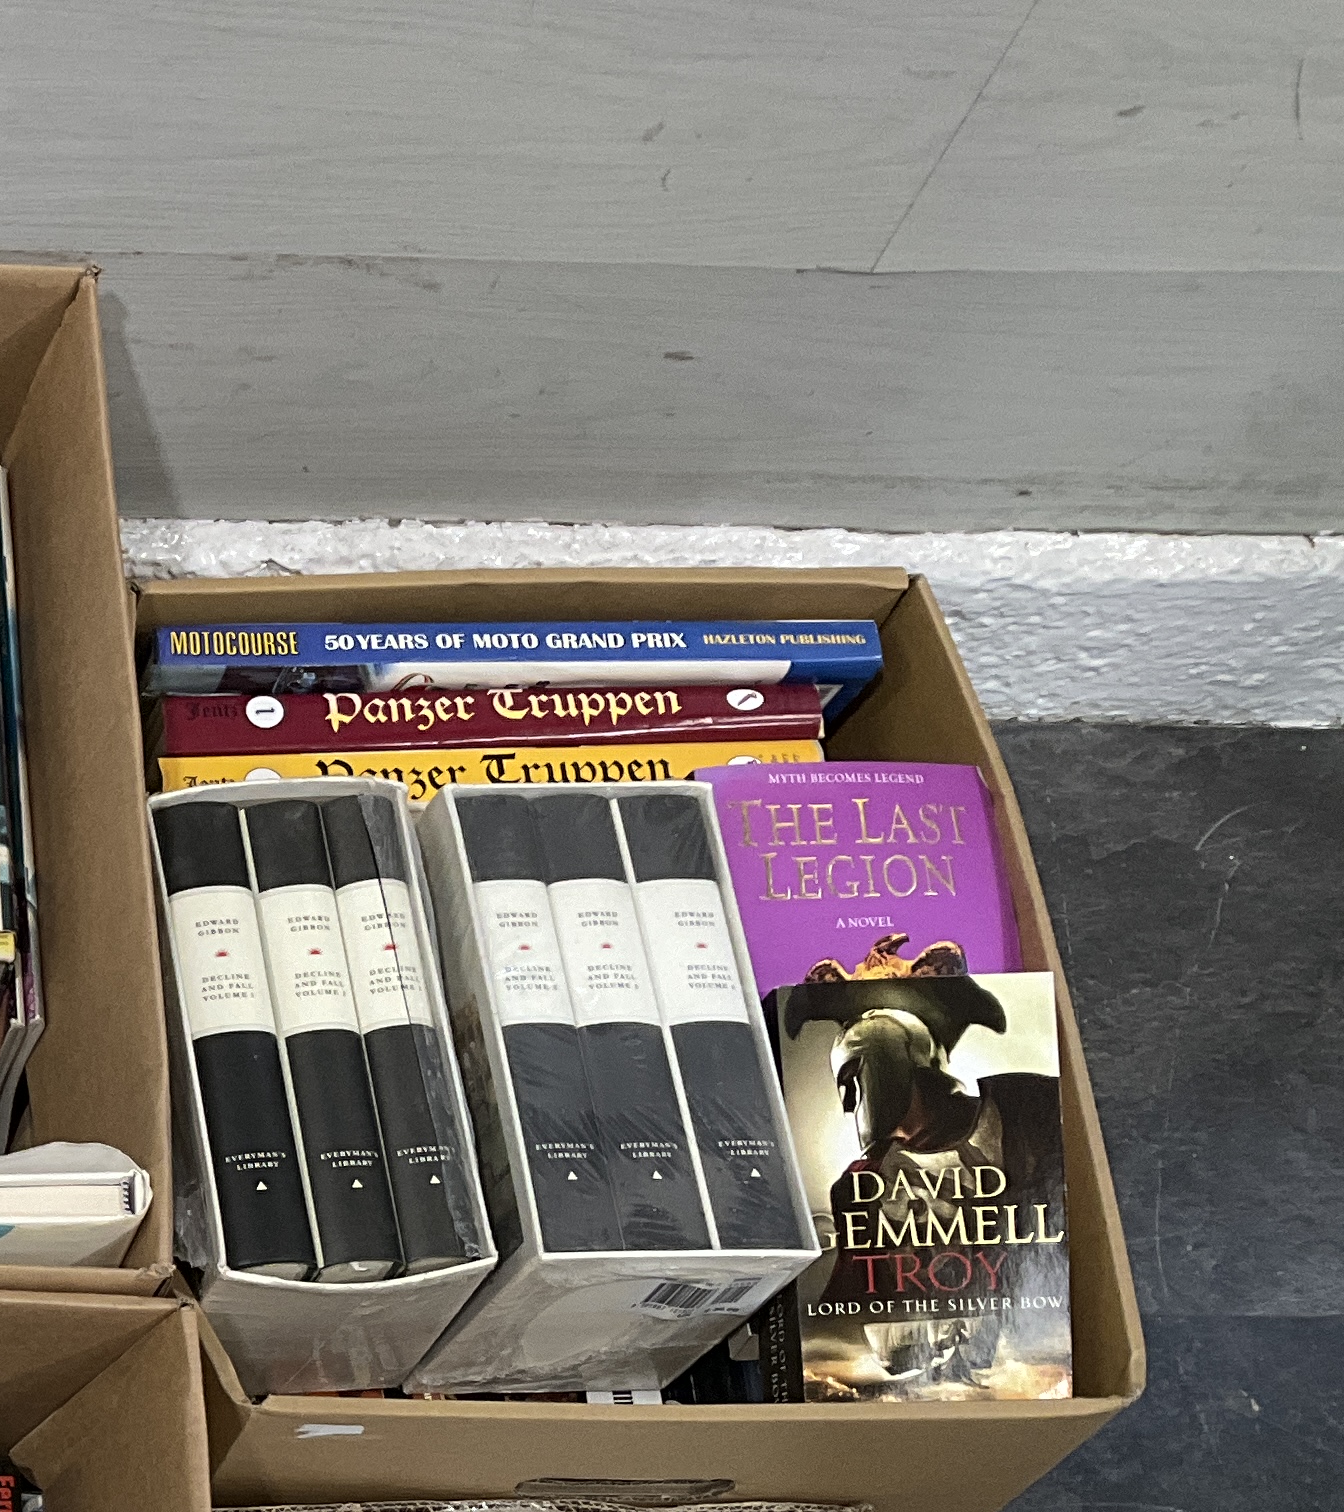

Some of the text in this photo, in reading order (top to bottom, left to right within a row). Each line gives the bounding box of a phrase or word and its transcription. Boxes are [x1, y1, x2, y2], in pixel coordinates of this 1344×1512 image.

[171, 630, 686, 657] MOTOCOURSE 50 YEARS OF MOTO GRAND PRIX
[703, 632, 865, 645] HAZLETON PUBLISHING
[324, 688, 682, 731] Panzer Truppen
[768, 773, 924, 785] MYTH BECOMES LEGEND
[731, 800, 965, 846] THE LAST
[759, 852, 959, 900] LEGION
[195, 918, 238, 928] EDWARD
[198, 927, 240, 936] GIBBON
[835, 917, 894, 929] A NOVEL
[225, 1151, 286, 1164] EVERYMAN'S
[237, 1160, 279, 1171] LIBRARY
[851, 1167, 1007, 1203] DAVID
[813, 1204, 1064, 1250] GEMMELL
[853, 1252, 1008, 1294] TROY
[807, 1296, 1062, 1317] LORD OF THE SILVER BOW
